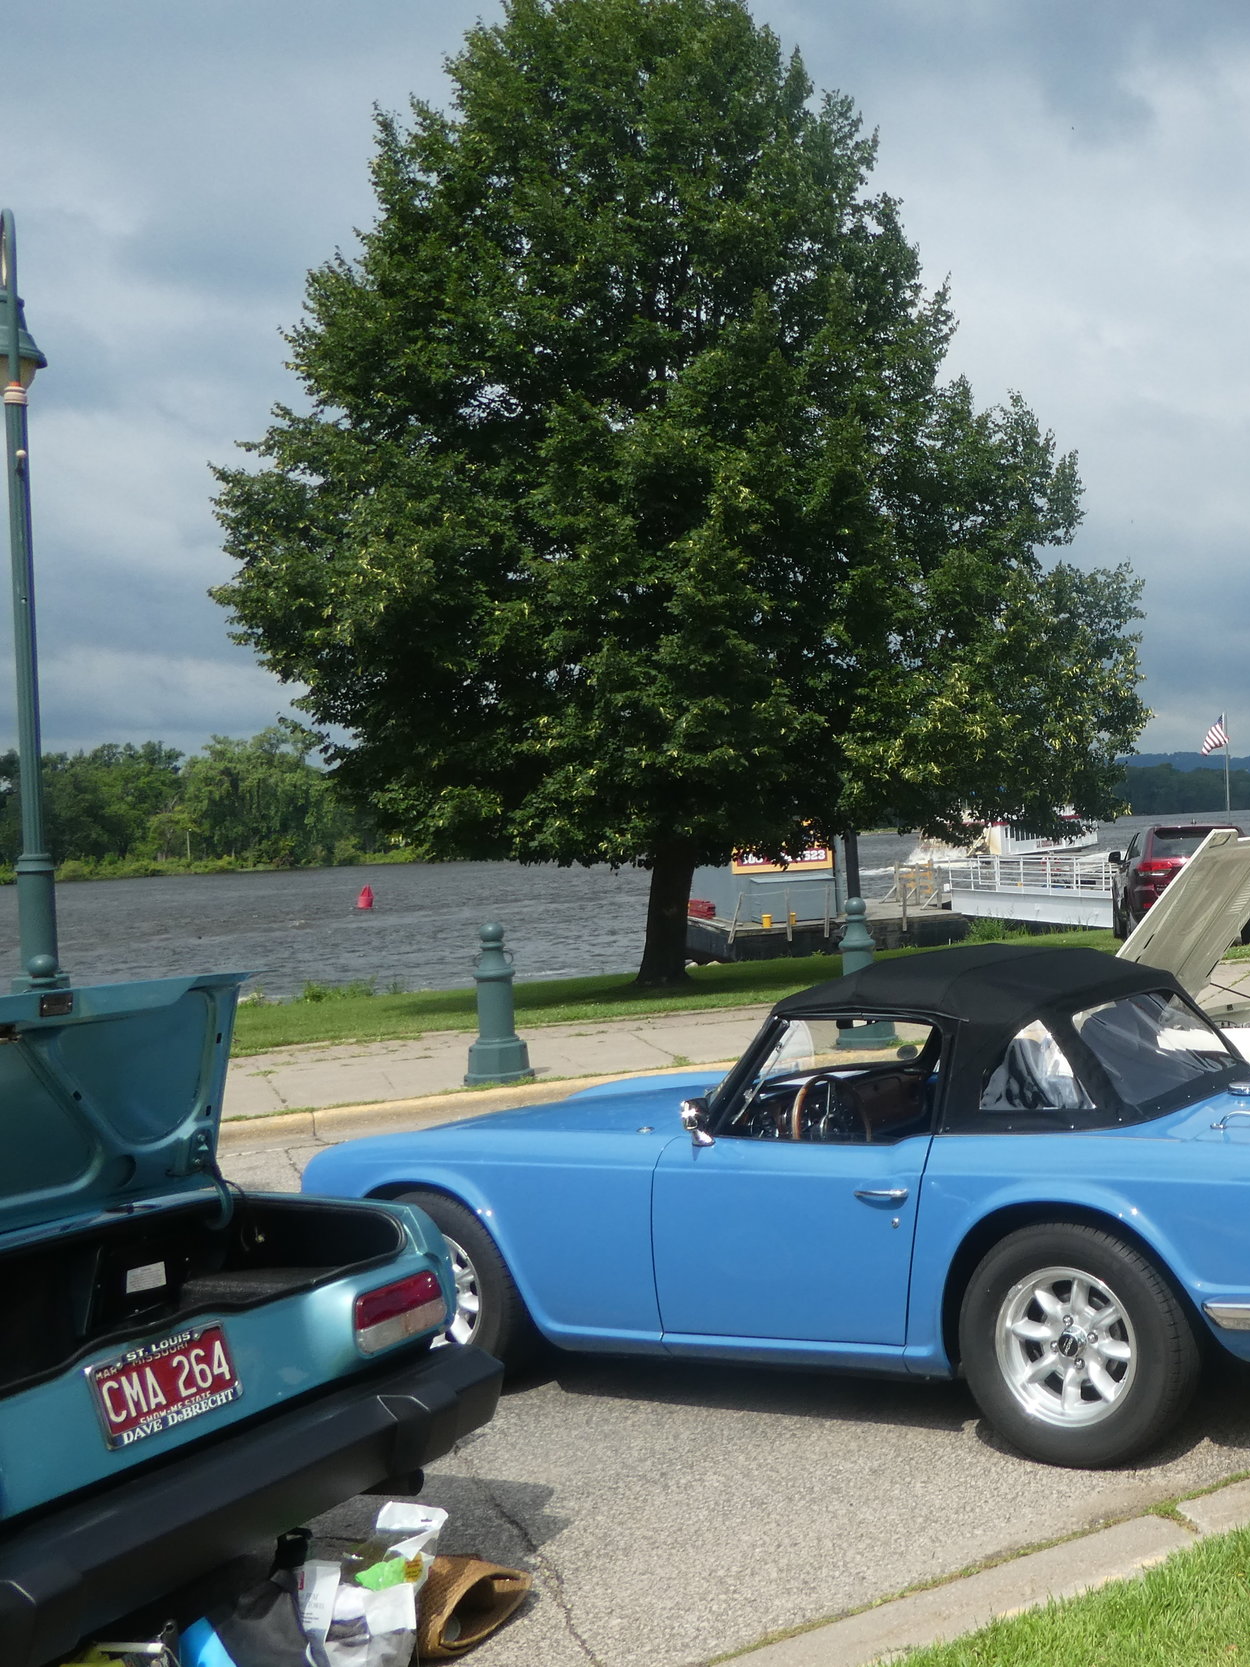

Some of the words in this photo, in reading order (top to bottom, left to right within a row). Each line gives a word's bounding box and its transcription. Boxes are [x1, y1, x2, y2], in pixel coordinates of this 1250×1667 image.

[126, 1348, 149, 1361] ST.
[151, 1331, 191, 1352] LOUIS
[102, 1367, 167, 1423] CMA
[172, 1340, 231, 1398] 264
[122, 1418, 163, 1445] DAVE
[167, 1388, 234, 1426] DeBRECHT
